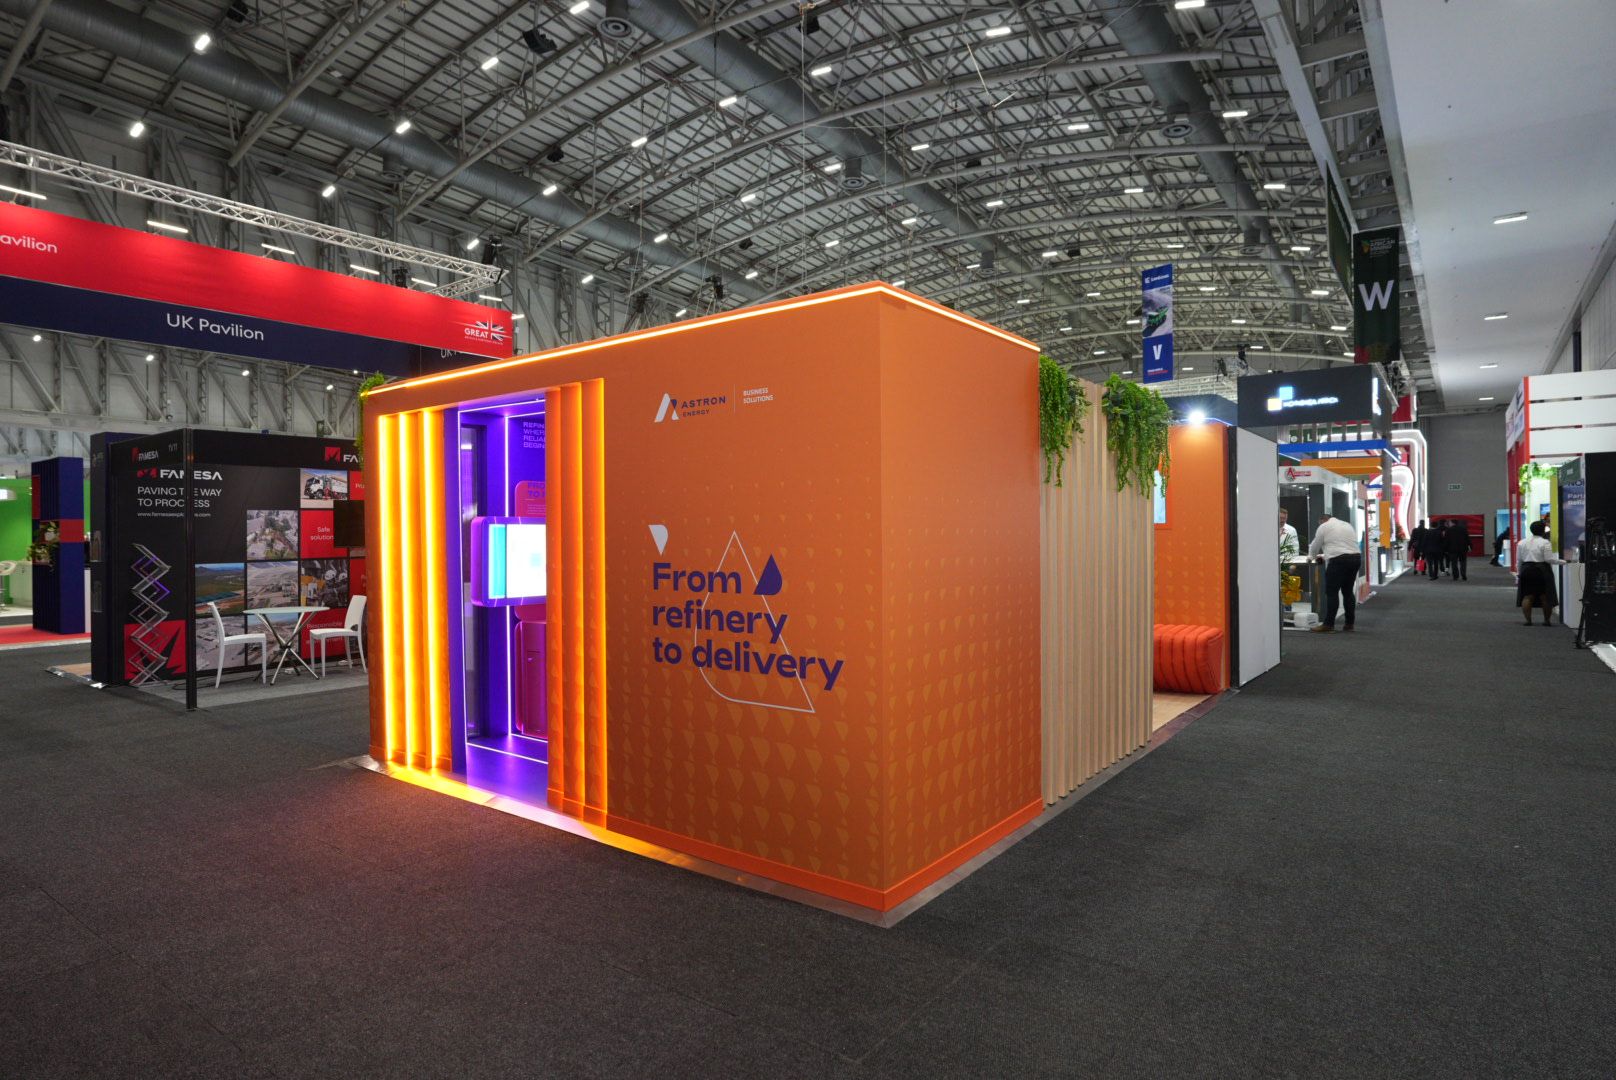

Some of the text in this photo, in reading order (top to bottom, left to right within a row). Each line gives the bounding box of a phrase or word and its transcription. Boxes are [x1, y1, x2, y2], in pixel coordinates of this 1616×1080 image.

[1358, 279, 1395, 311] W
[166, 313, 264, 341] UK Pavilion
[464, 328, 489, 339] GREAT
[1152, 344, 1162, 360] V
[743, 387, 769, 396] BUSINESS
[681, 396, 727, 409] ASTRON
[743, 395, 774, 404] SOLUTIONS
[683, 409, 710, 417] ENERGY
[159, 469, 223, 481] FAESA
[137, 486, 222, 497] PAVING TE WAY
[137, 498, 153, 507] TO
[652, 562, 743, 594] From
[652, 598, 789, 644] refinery
[652, 636, 845, 692] to delivery
